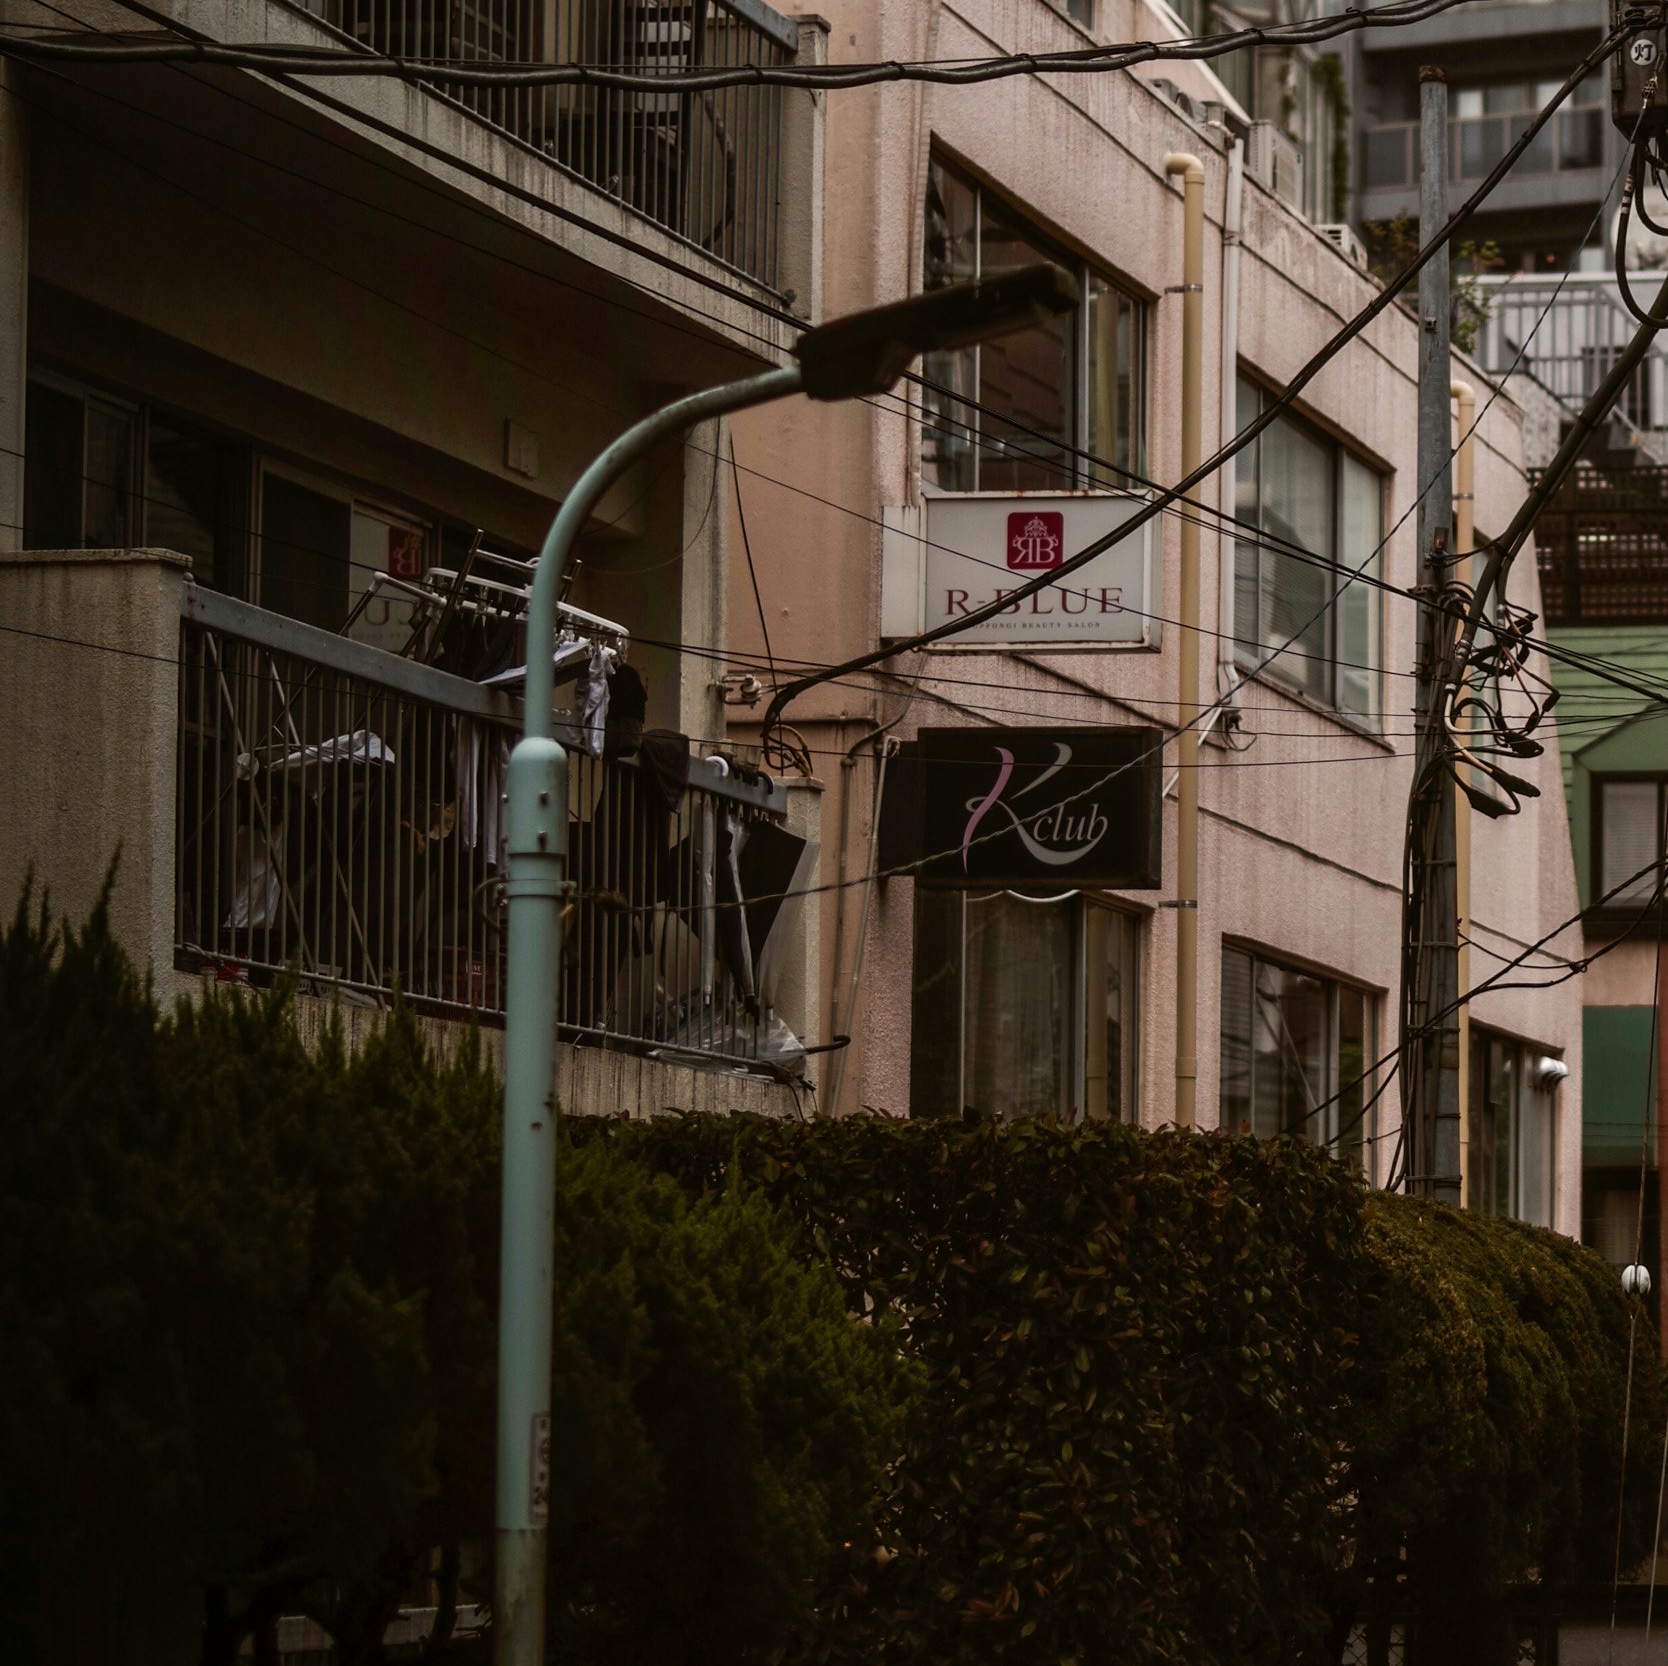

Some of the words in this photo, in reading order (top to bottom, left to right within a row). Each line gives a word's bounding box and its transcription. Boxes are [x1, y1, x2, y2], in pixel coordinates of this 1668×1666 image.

[1634, 43, 1654, 62] 灯
[1022, 621, 1062, 629] BEAUTY
[1067, 621, 1102, 629] SALON
